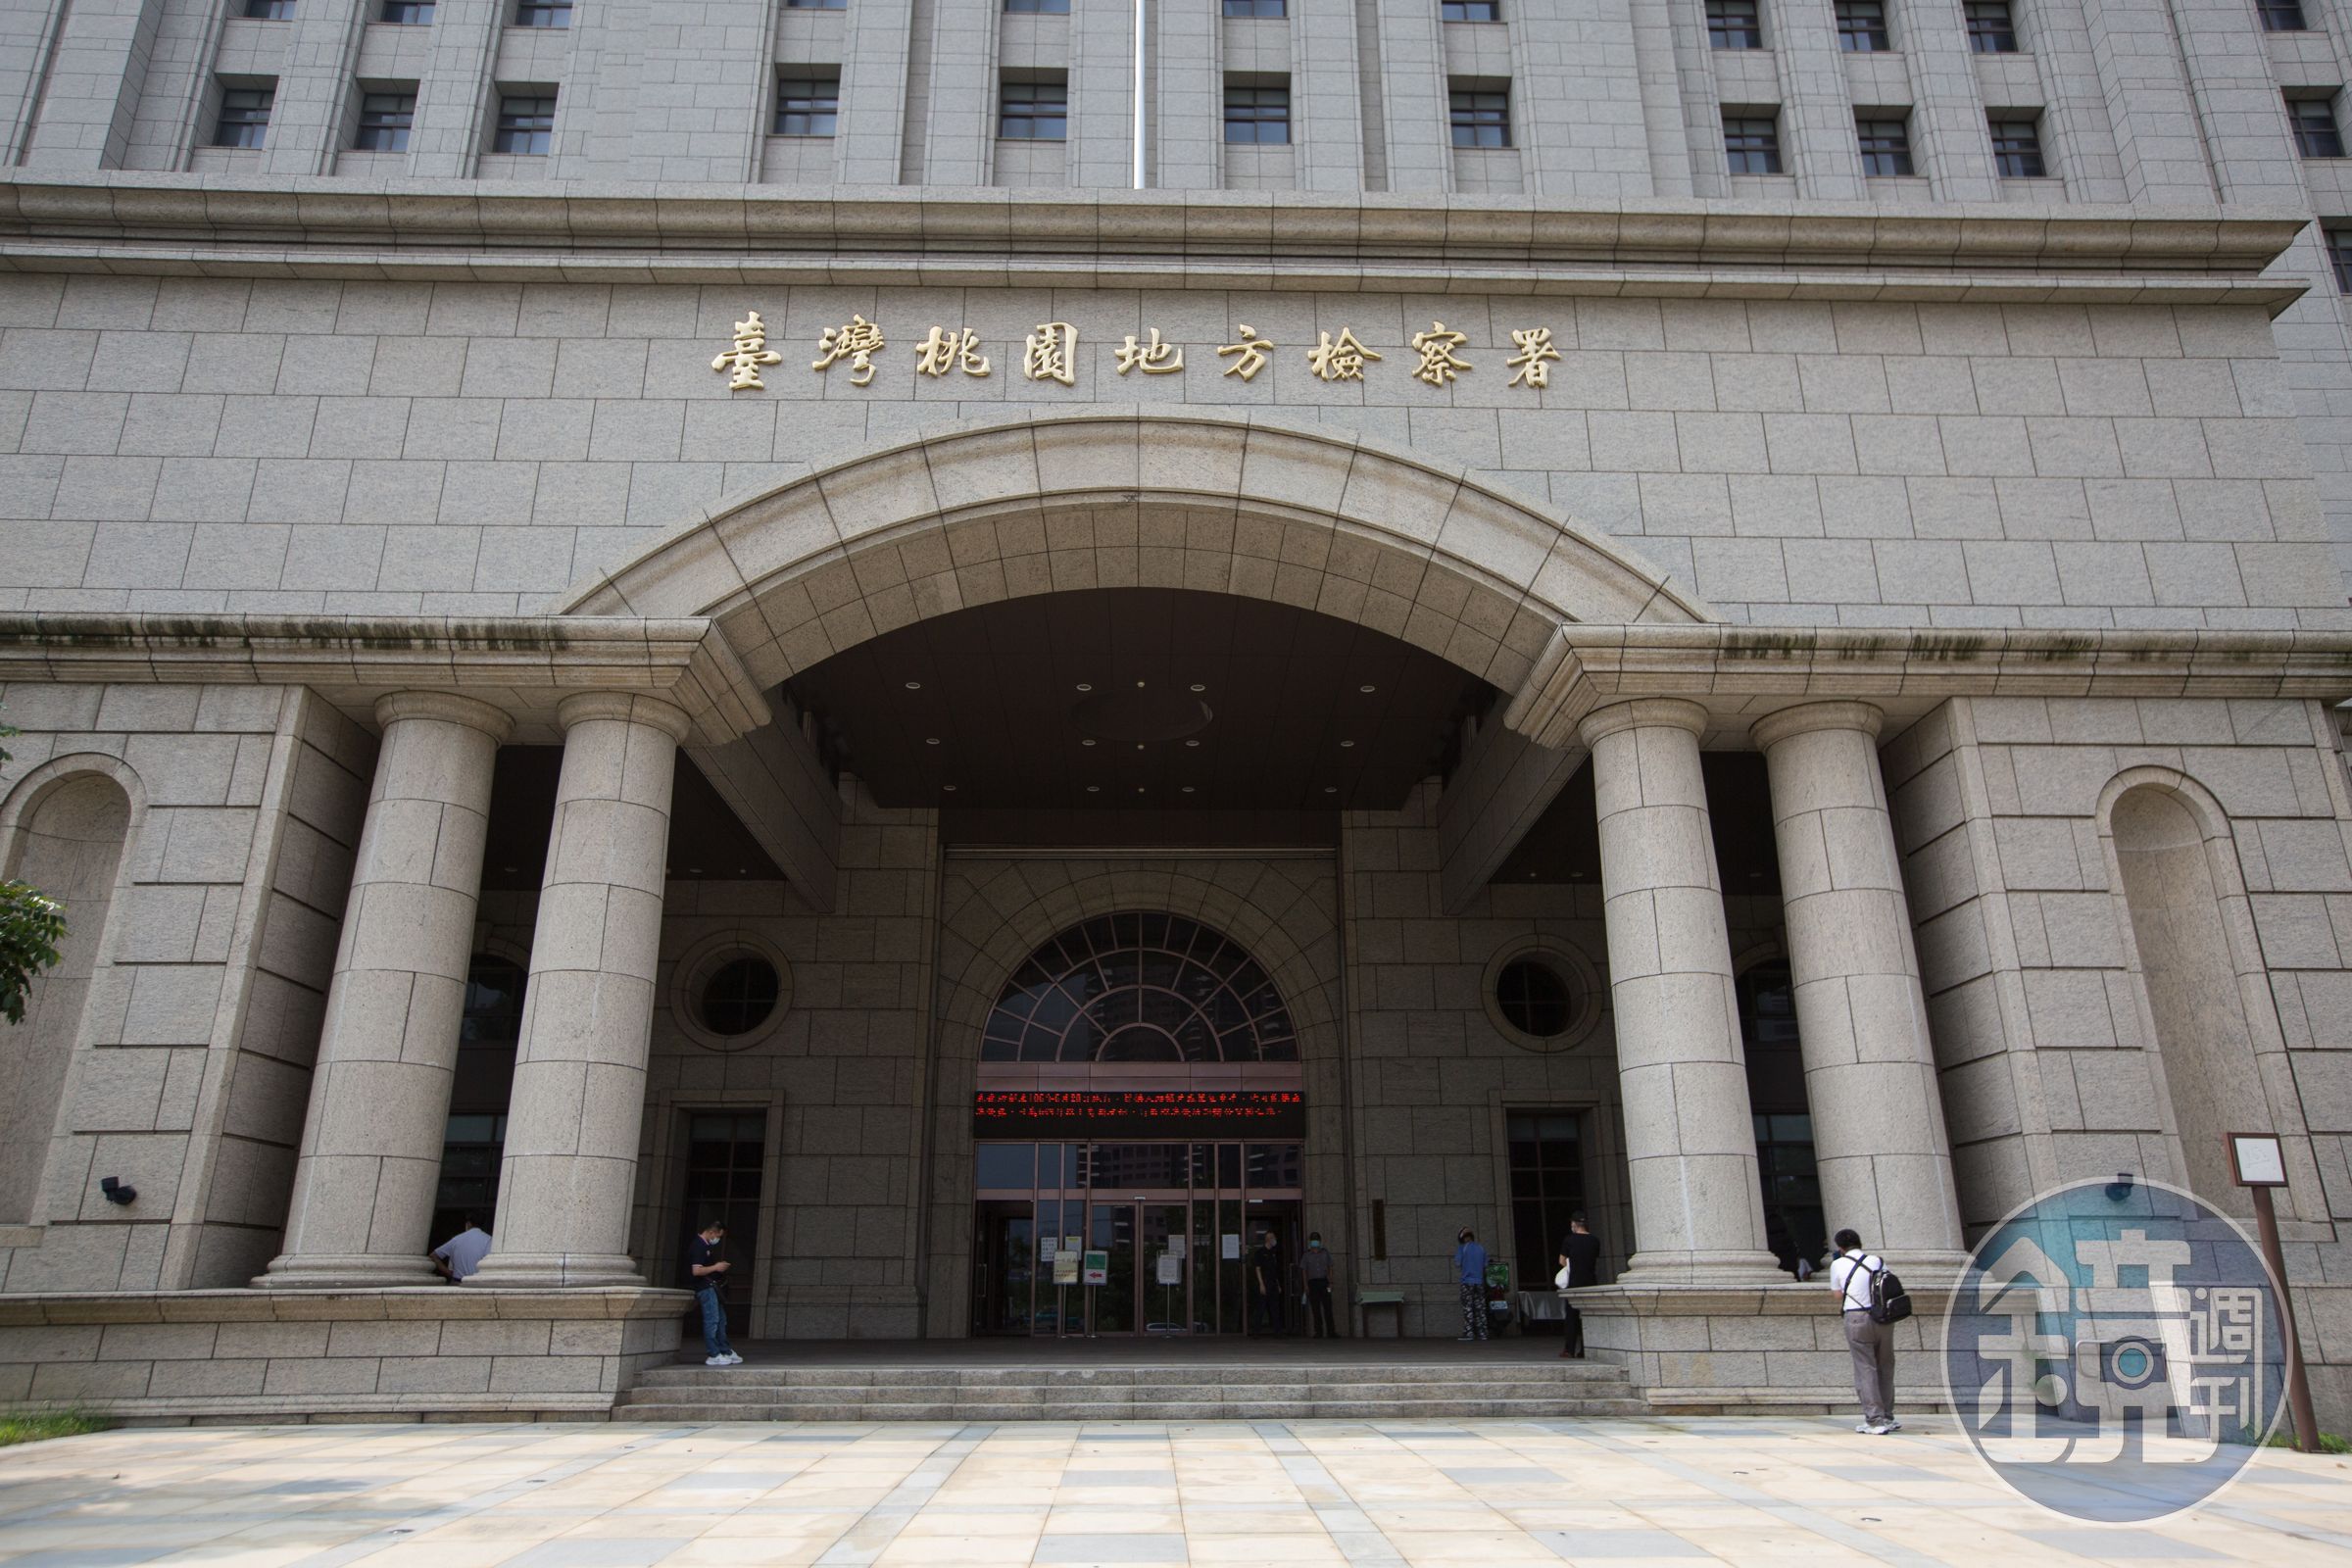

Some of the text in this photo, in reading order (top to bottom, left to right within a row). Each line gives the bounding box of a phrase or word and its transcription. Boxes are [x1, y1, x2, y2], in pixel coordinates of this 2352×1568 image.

[711, 311, 1562, 391] 臺灣桃園地方檢察署
